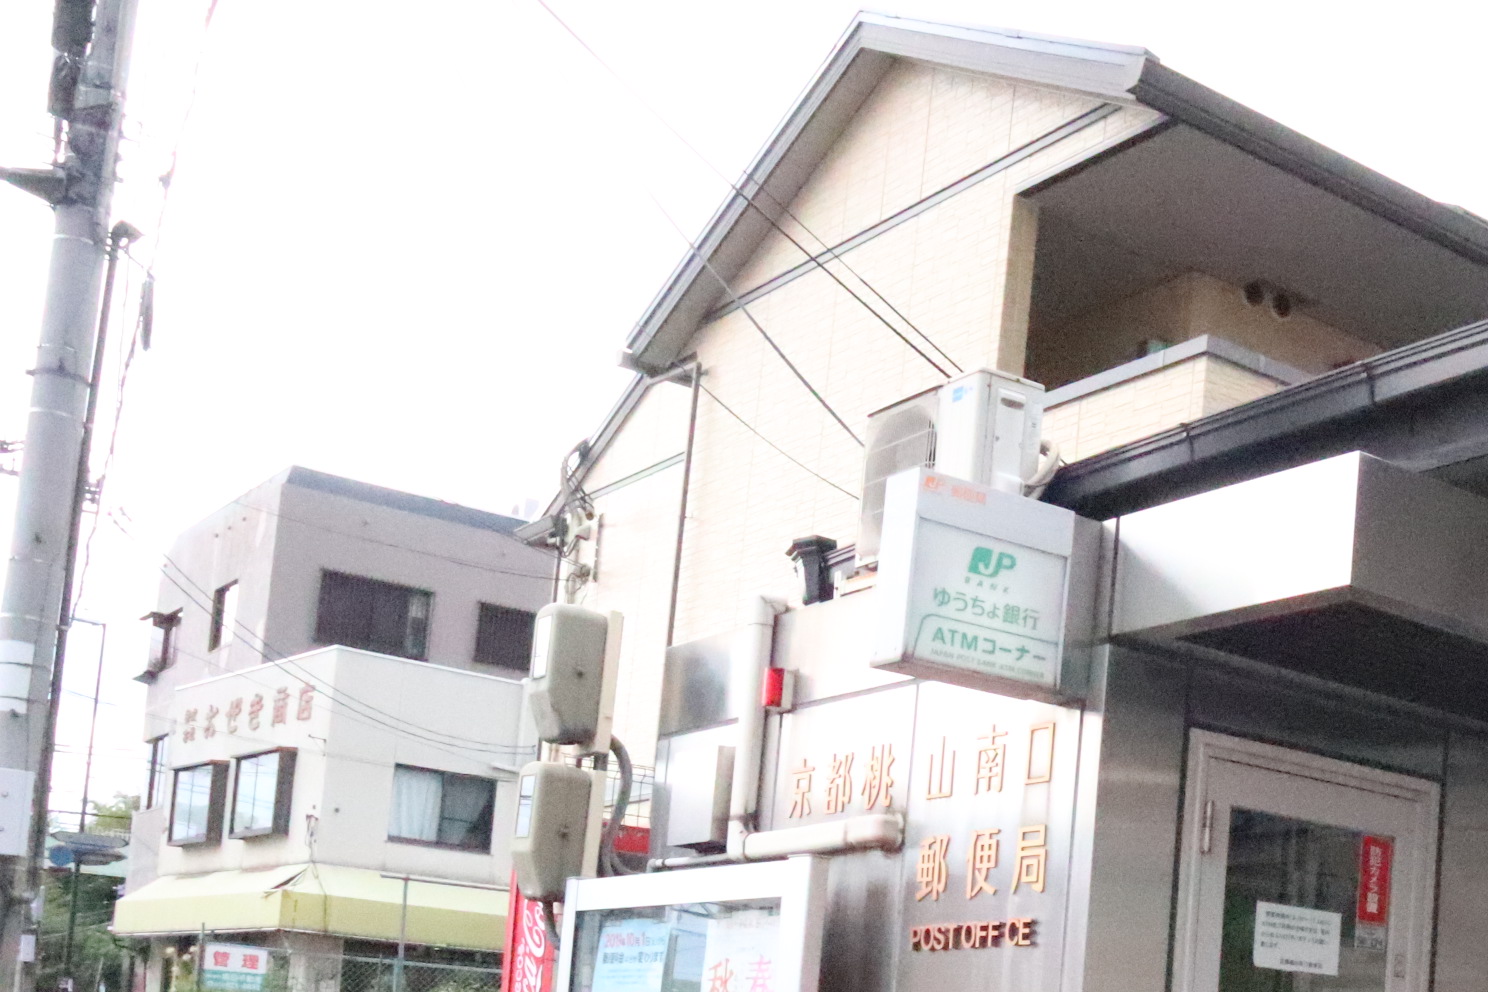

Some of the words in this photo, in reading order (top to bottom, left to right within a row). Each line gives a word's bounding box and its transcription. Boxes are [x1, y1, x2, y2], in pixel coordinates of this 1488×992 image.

[968, 546, 1017, 578] JP
[933, 586, 1040, 630] ゆうちょ銀行
[932, 626, 1046, 663] ATMコーナー
[789, 722, 1056, 819] 京都桃山南口
[915, 824, 1048, 901] 郵便局
[910, 924, 957, 951] POST
[961, 917, 1032, 949] OFFCE
